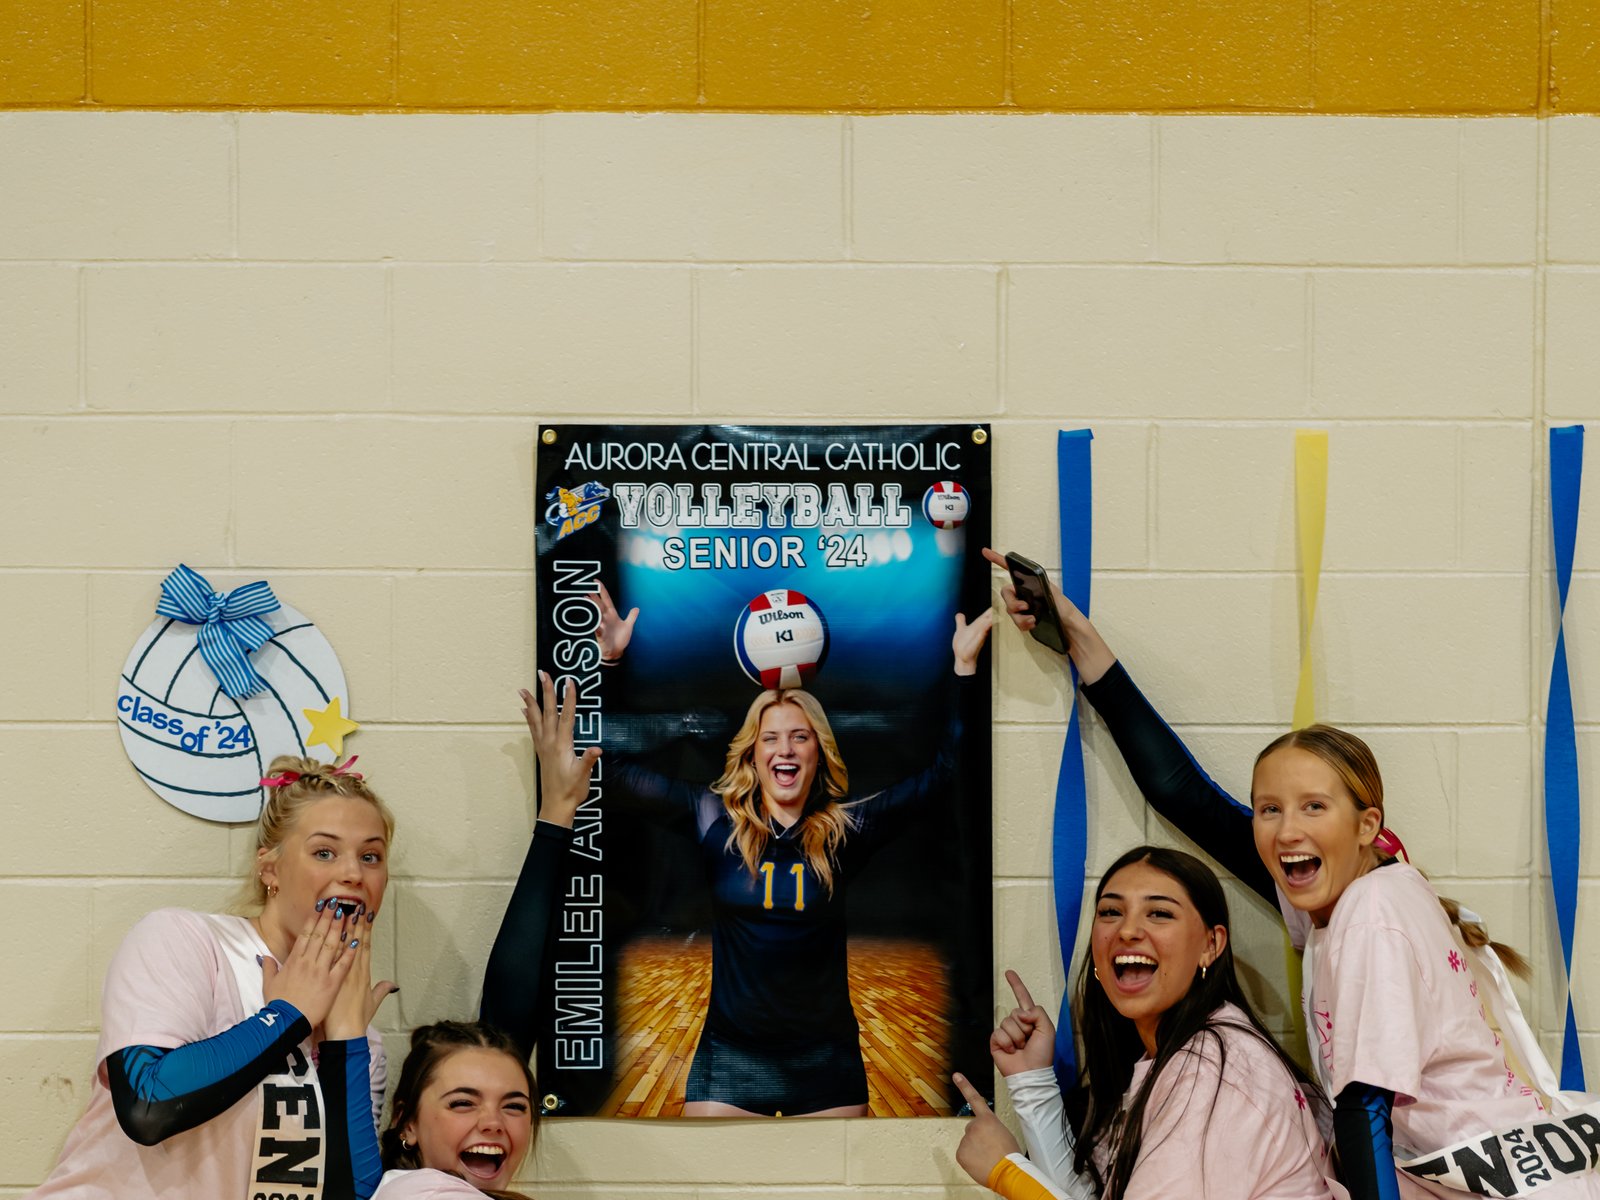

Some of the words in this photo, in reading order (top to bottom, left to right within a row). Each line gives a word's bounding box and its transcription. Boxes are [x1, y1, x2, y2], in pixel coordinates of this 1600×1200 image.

[564, 442, 687, 471] AURORA
[691, 442, 821, 471] CENTRAL
[824, 441, 961, 471] CATHOLIC
[556, 504, 601, 541] ACC
[613, 482, 912, 529] VOLLEYBALL
[663, 535, 807, 570] SENIOR
[758, 609, 805, 625] Wilson
[775, 629, 794, 643] K1
[180, 726, 210, 752] of
[555, 874, 603, 1069] EMILEE
[1502, 1128, 1552, 1188] 2024
